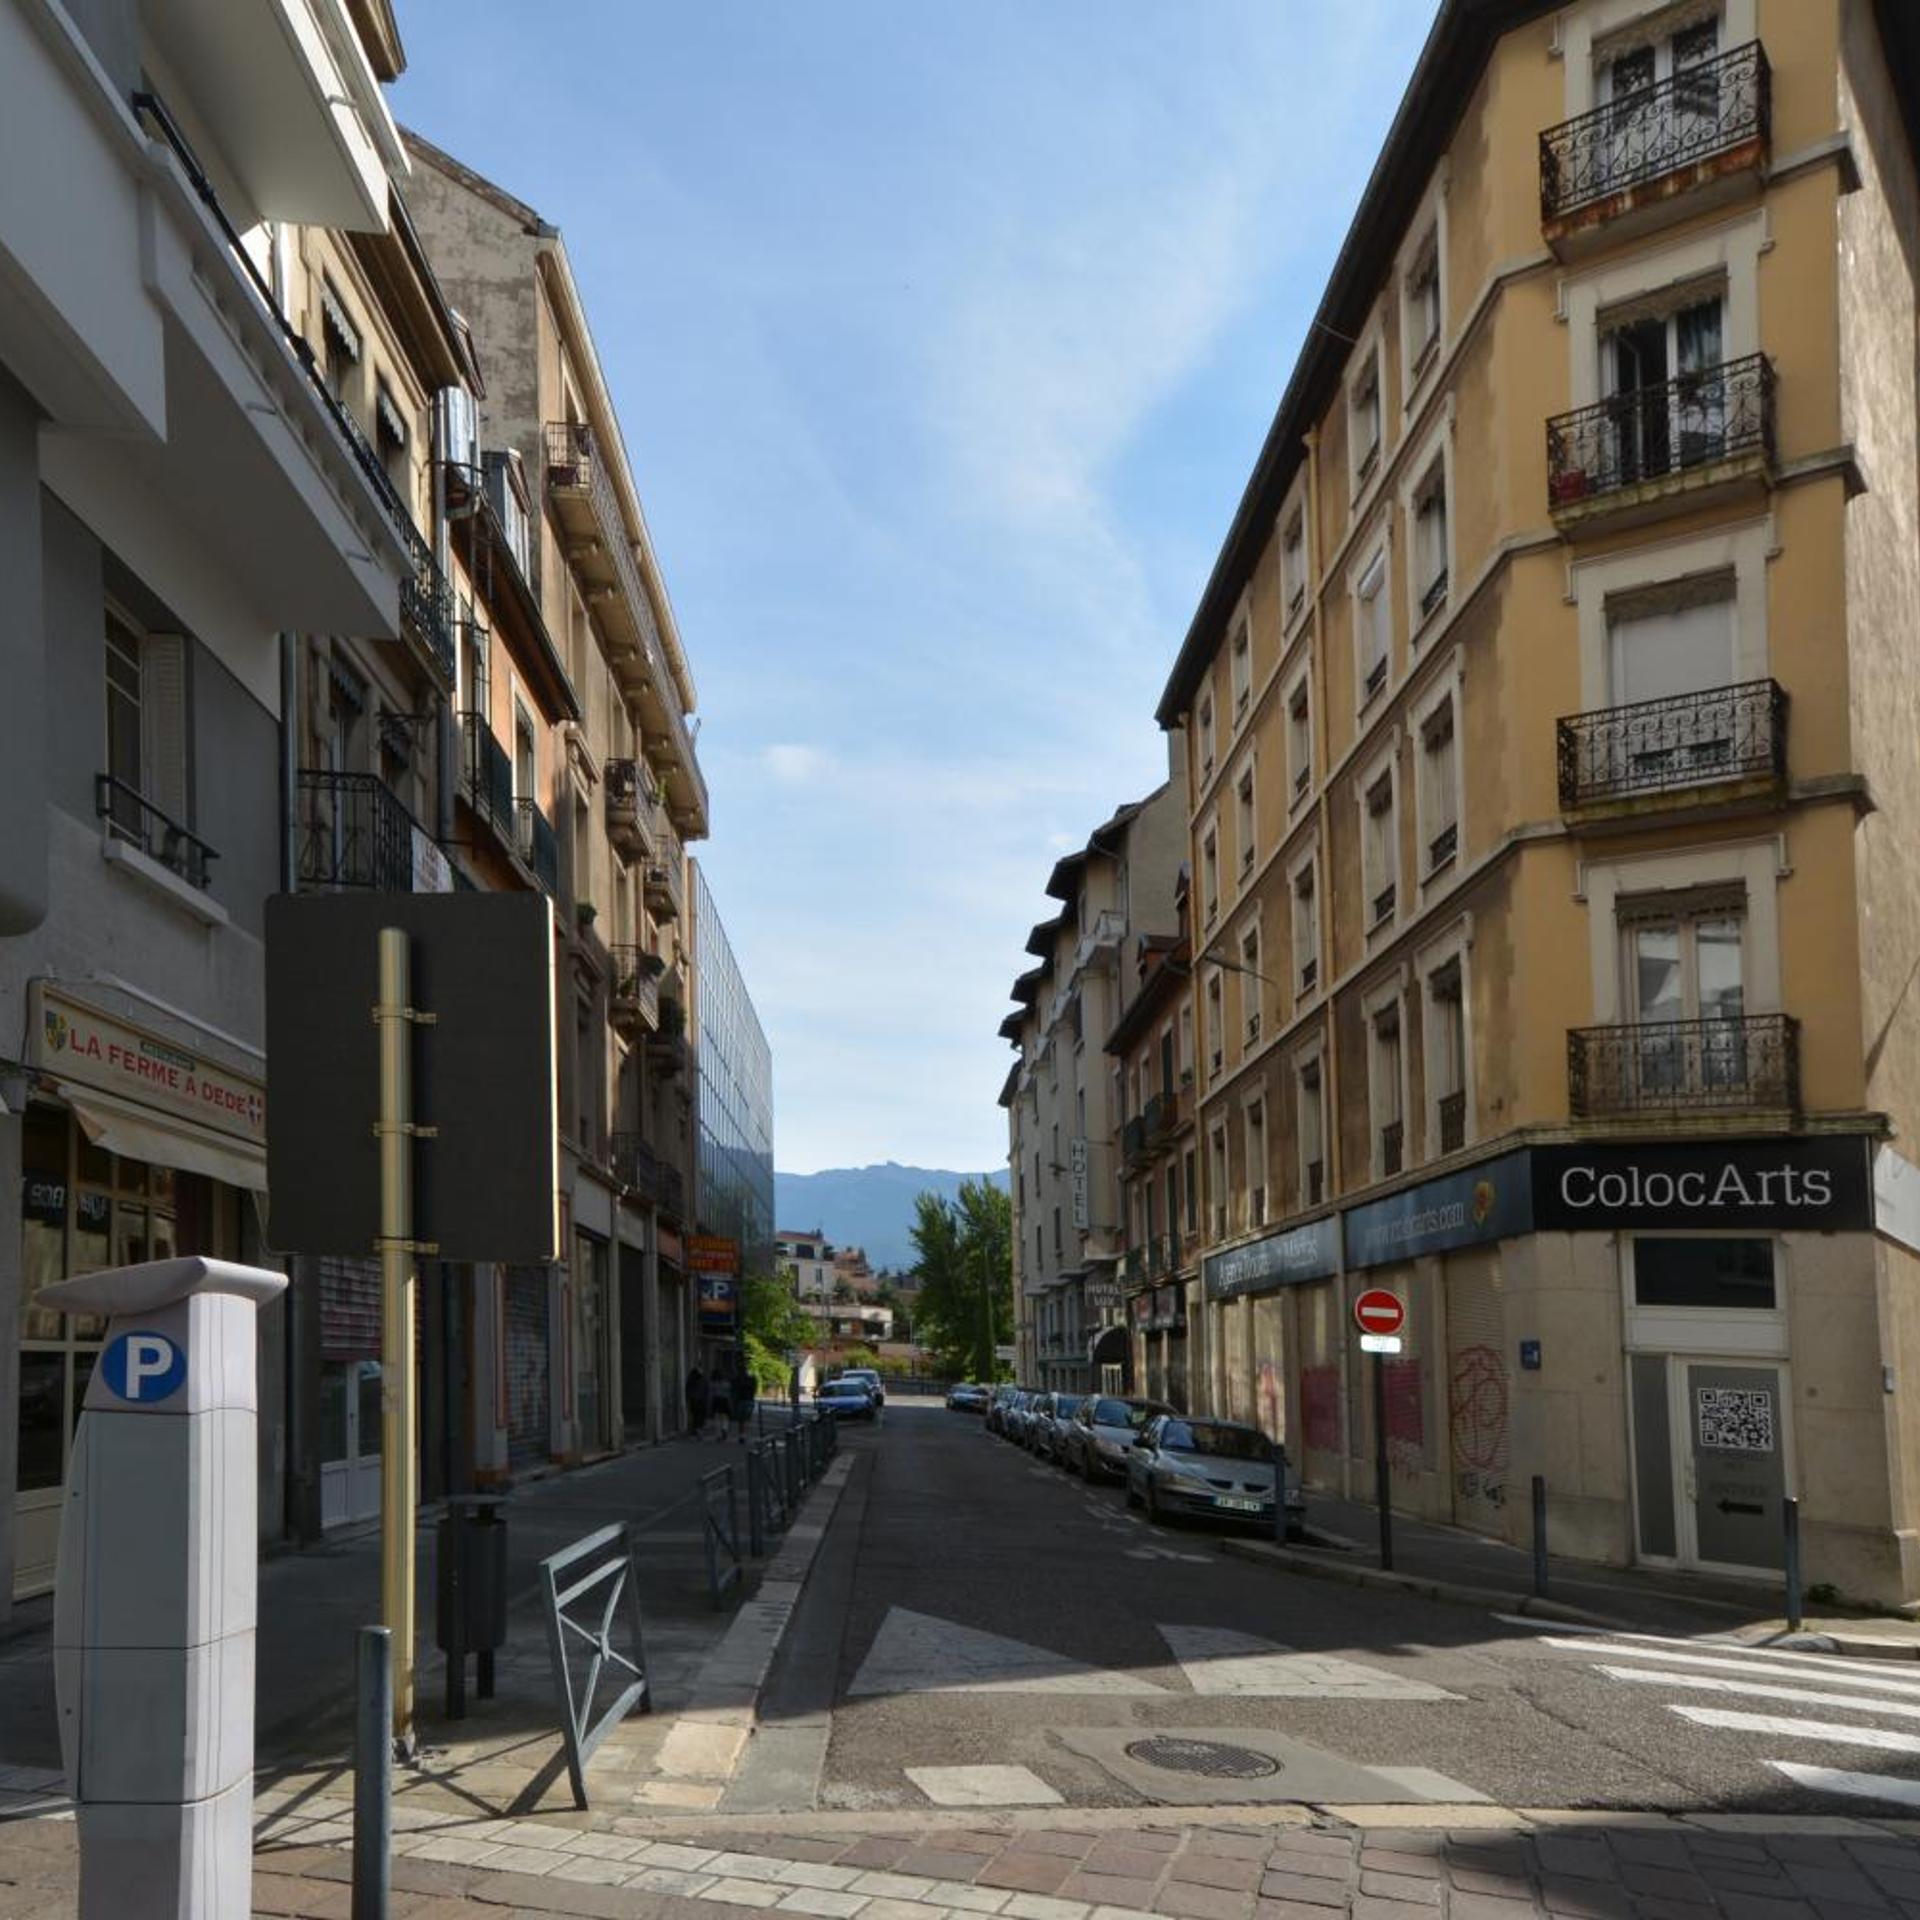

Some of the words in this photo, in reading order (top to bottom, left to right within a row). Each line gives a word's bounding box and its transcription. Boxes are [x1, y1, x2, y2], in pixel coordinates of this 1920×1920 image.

[70, 1028, 102, 1060] LA
[108, 1043, 179, 1089] FERME
[186, 1075, 196, 1096] A
[1561, 1164, 1832, 1206] ColocArts
[126, 1336, 173, 1398] P
